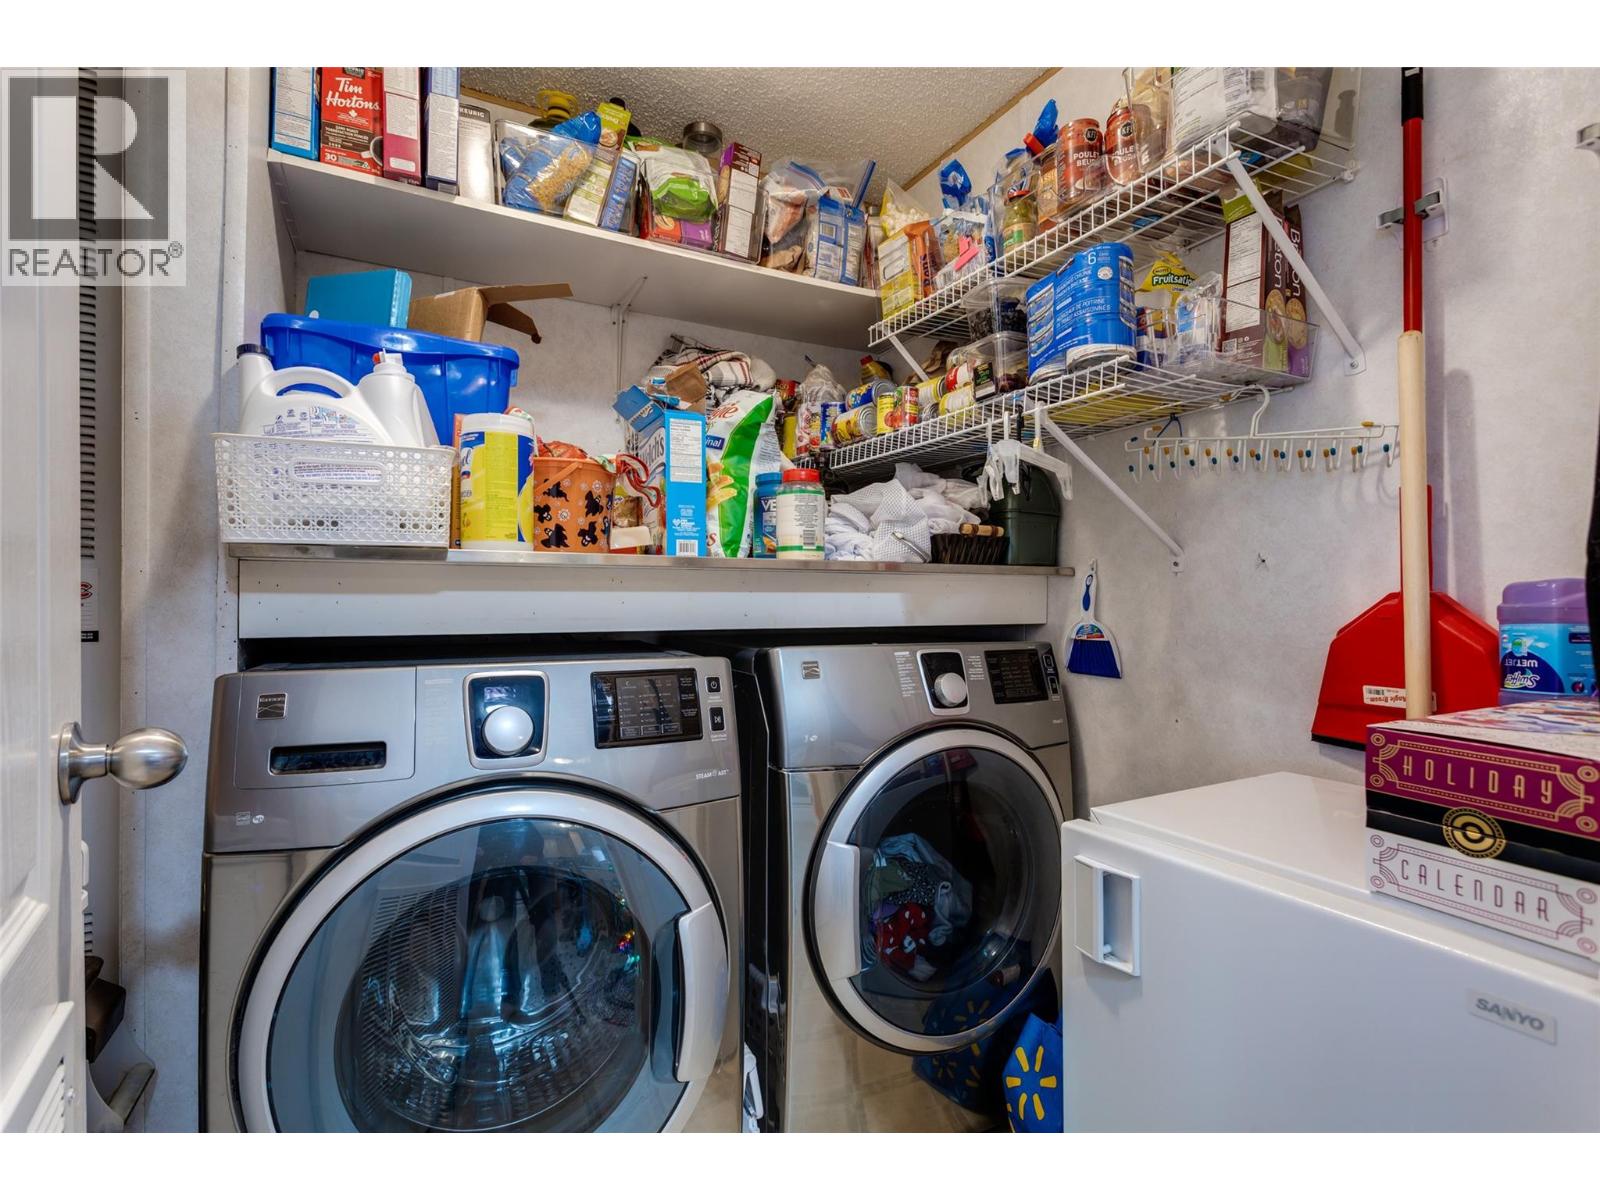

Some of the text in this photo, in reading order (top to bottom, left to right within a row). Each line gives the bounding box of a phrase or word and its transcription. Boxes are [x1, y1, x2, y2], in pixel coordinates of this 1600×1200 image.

[335, 77, 363, 94] Tim
[326, 90, 380, 110] Hortons
[459, 107, 485, 118] KEURIG
[324, 152, 338, 162] 30
[1088, 252, 1097, 265] 6
[1152, 274, 1194, 286] Fruitsatio
[1504, 659, 1539, 668] WETJET
[1505, 670, 1541, 689] Swiffer
[1402, 754, 1553, 804] HOLIDAY
[1400, 858, 1550, 922] CALENDAR
[1475, 998, 1545, 1031] SANYO
